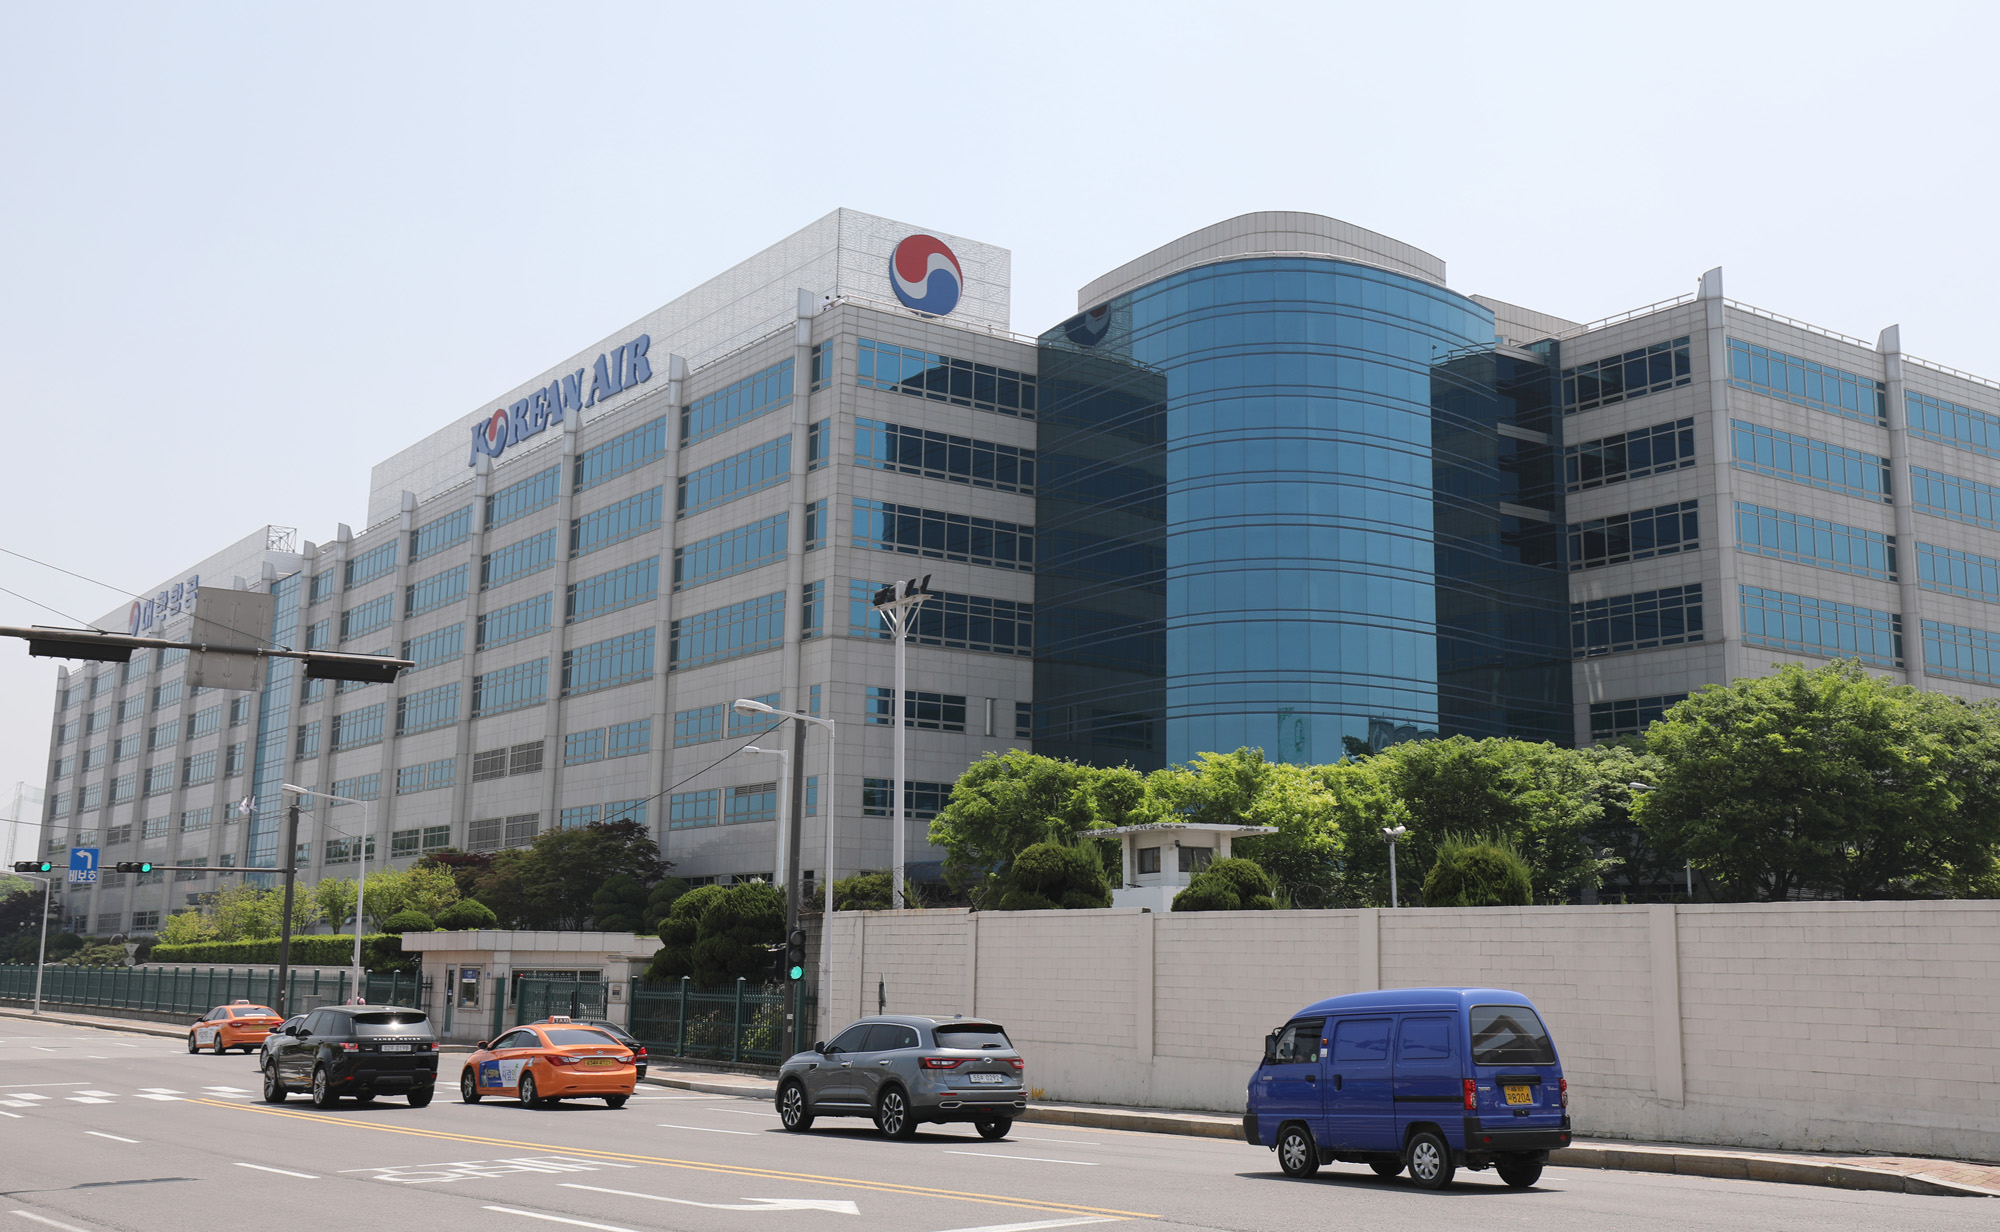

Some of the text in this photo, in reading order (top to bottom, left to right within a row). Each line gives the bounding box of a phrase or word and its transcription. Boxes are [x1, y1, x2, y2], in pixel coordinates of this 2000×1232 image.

[468, 334, 653, 468] KOREAN AIR
[69, 870, 97, 883] 비보호
[1511, 1093, 1531, 1103] 8204
